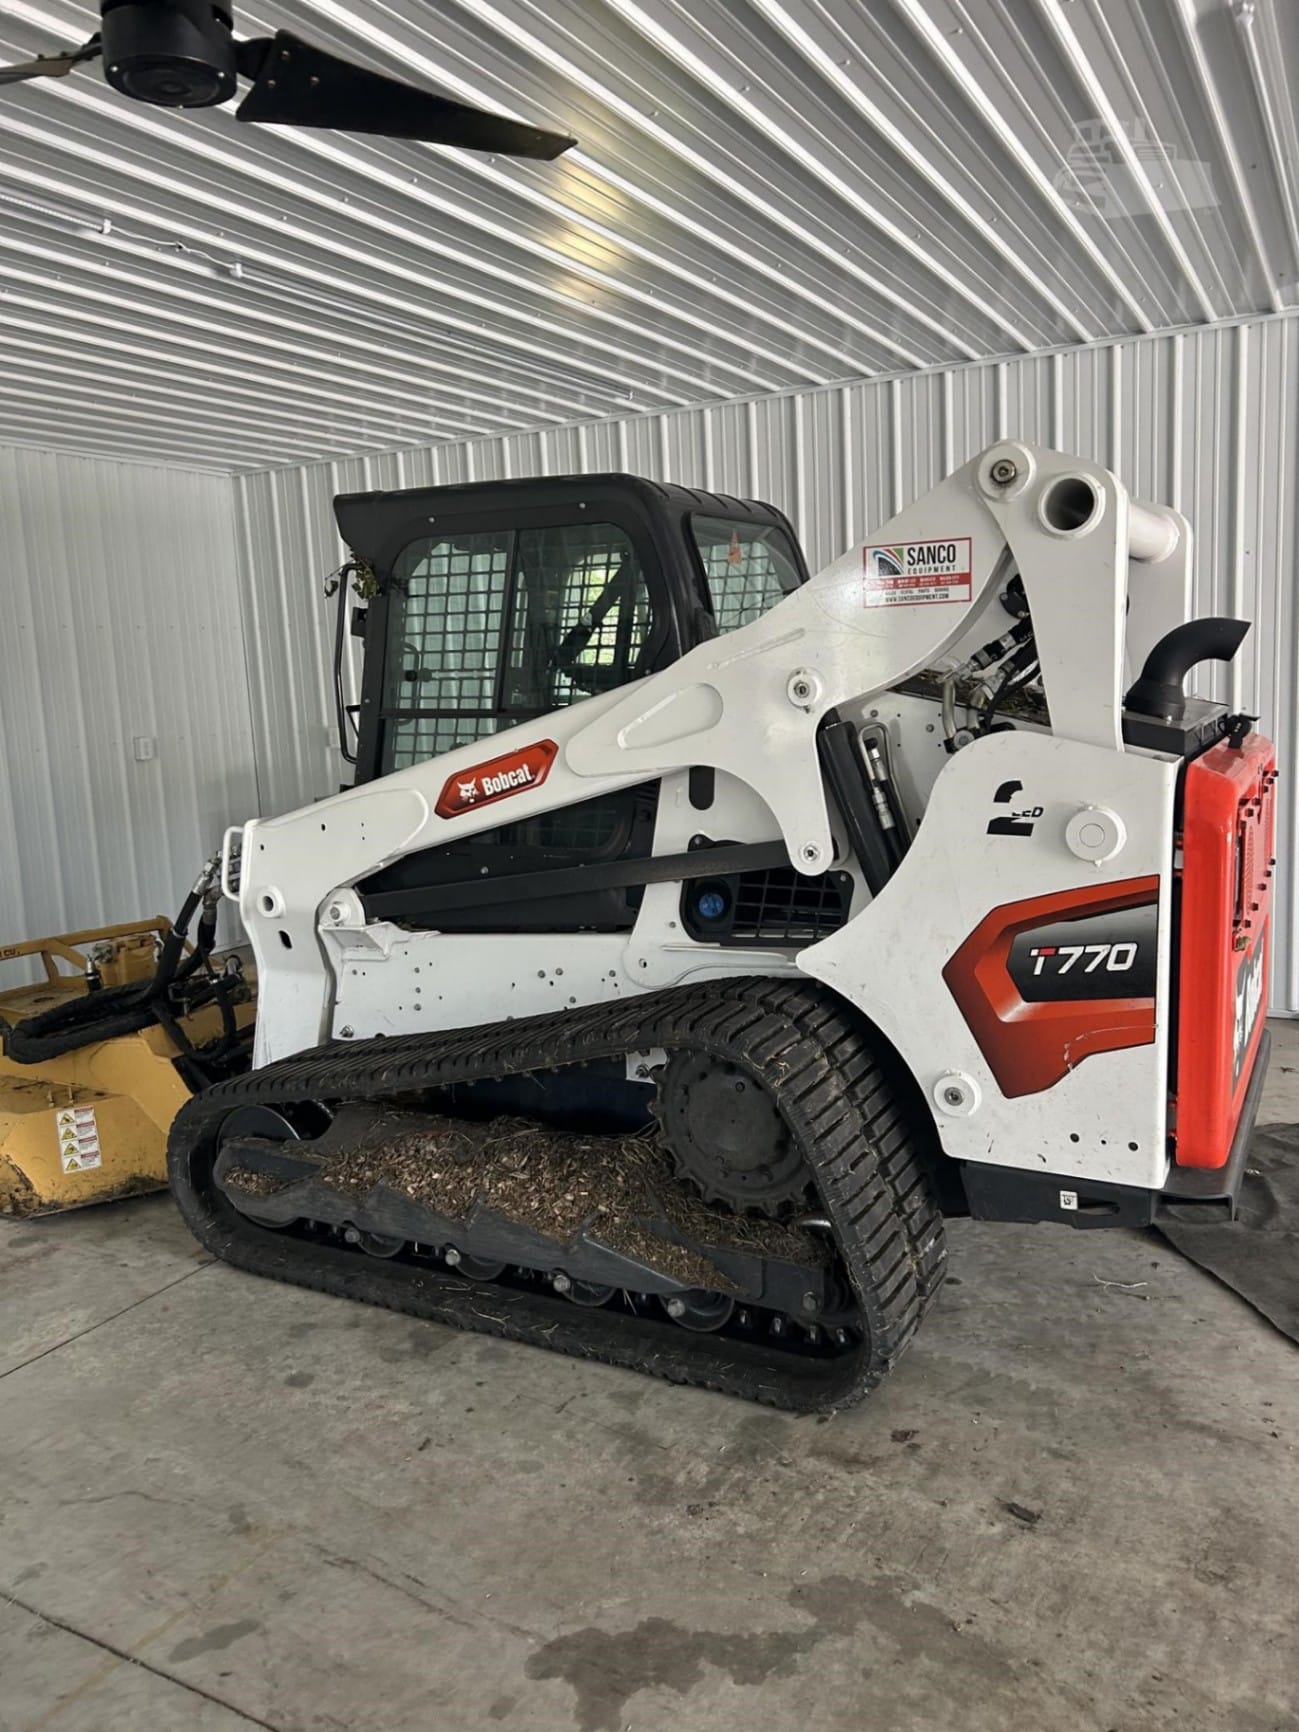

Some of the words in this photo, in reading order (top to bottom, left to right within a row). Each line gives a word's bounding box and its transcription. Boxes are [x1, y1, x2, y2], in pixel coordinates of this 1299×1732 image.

[907, 544, 956, 566] SANCO
[908, 565, 956, 575] EQUIPMENT
[480, 763, 532, 796] Bobcat
[1030, 942, 1138, 976] T770
